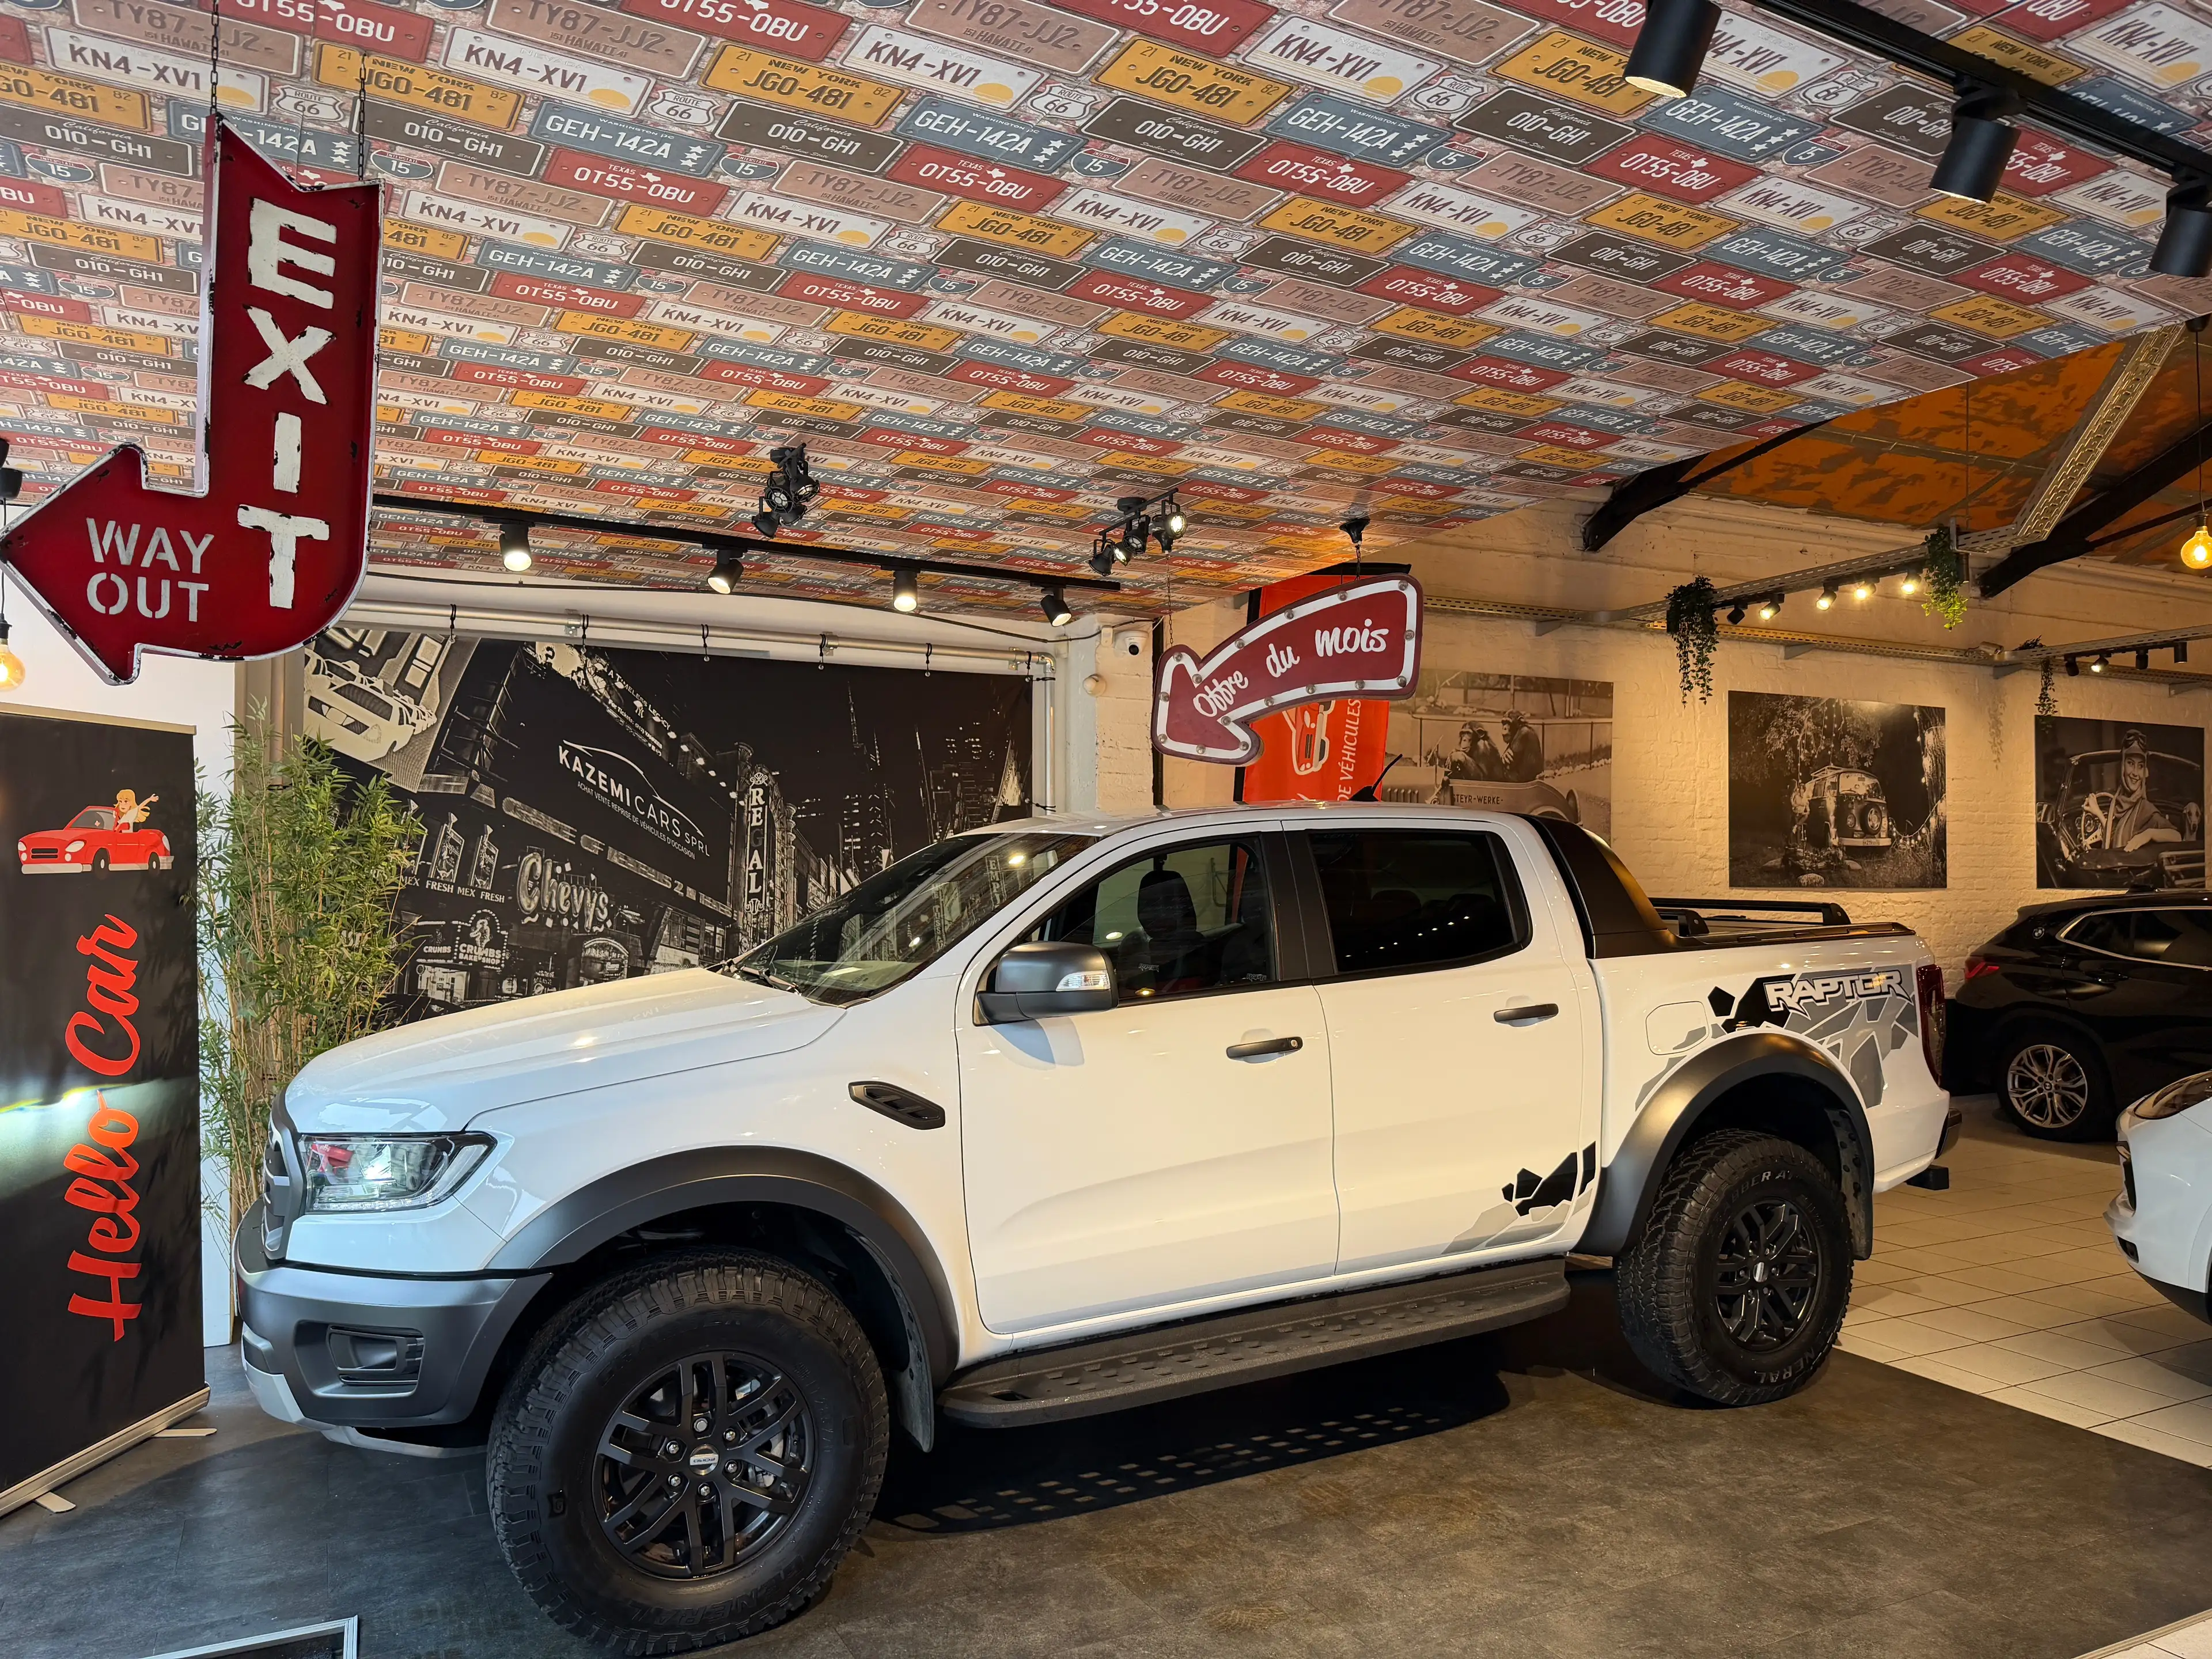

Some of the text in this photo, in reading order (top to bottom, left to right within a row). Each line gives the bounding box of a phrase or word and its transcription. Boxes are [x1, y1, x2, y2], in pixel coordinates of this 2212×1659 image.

[736, 52, 753, 61] 21
[1139, 47, 1160, 56] 21
[1990, 38, 2054, 71] NEW YORK
[767, 59, 863, 88] NEW YORK
[1168, 55, 1256, 85] NEW YORK
[293, 90, 324, 101] ROUTE
[871, 87, 892, 97] 82
[1055, 89, 1085, 100] ROUTE
[1258, 84, 1281, 94] 82
[1444, 81, 1475, 92] ROUTE
[672, 95, 702, 106] ROUTE
[1041, 101, 1073, 113] 66
[1423, 93, 1457, 105] 66
[294, 103, 320, 115] 66
[665, 107, 694, 119] 66
[1542, 107, 1593, 127] California
[425, 119, 488, 138] California
[793, 119, 851, 138] California
[1164, 116, 1219, 135] California
[1283, 107, 1400, 149] GEH-142A
[1660, 99, 1772, 142] GEH-142A
[544, 116, 670, 157] GEH-142A
[911, 111, 1033, 153] GEH-142A
[1309, 156, 1339, 166] TEXAS
[1435, 151, 1465, 165] 15
[1667, 150, 1696, 160] TEXAS
[390, 160, 411, 173] 15
[608, 164, 637, 175] TEXAS
[735, 162, 759, 175] 15
[956, 160, 986, 171] TEXAS
[1082, 158, 1109, 172] 15
[990, 211, 1065, 230] NEW YORK
[895, 242, 920, 250] 66
[790, 249, 892, 278] GEH-142A
[1405, 243, 1501, 271] GEH-142A
[448, 345, 539, 366] GEH-142A
[1491, 338, 1572, 359] GEH-142A
[237, 197, 338, 609] EXIT
[86, 517, 214, 574] WAY
[86, 572, 210, 623] OUT
[1266, 642, 1300, 679] du
[1315, 618, 1389, 658] mois
[1338, 698, 1362, 781] VÉHICULES
[577, 781, 594, 797] ACHAT
[594, 791, 611, 807] VENTE
[611, 801, 632, 820] REPRISE
[632, 815, 639, 825] DE
[639, 819, 666, 842] VÉHICULES
[684, 832, 710, 857] SPRL
[748, 787, 765, 893] REGAL
[425, 880, 454, 893] FRESH
[457, 886, 476, 898] MEX
[480, 891, 506, 903] FRESH
[517, 852, 609, 933] Chevys
[423, 945, 452, 954] CRUMBS
[459, 943, 502, 959] CRUMBS
[482, 957, 501, 965] SHOP
[1764, 970, 1914, 1020] RAPTOR
[63, 914, 143, 1342] Hello Car
